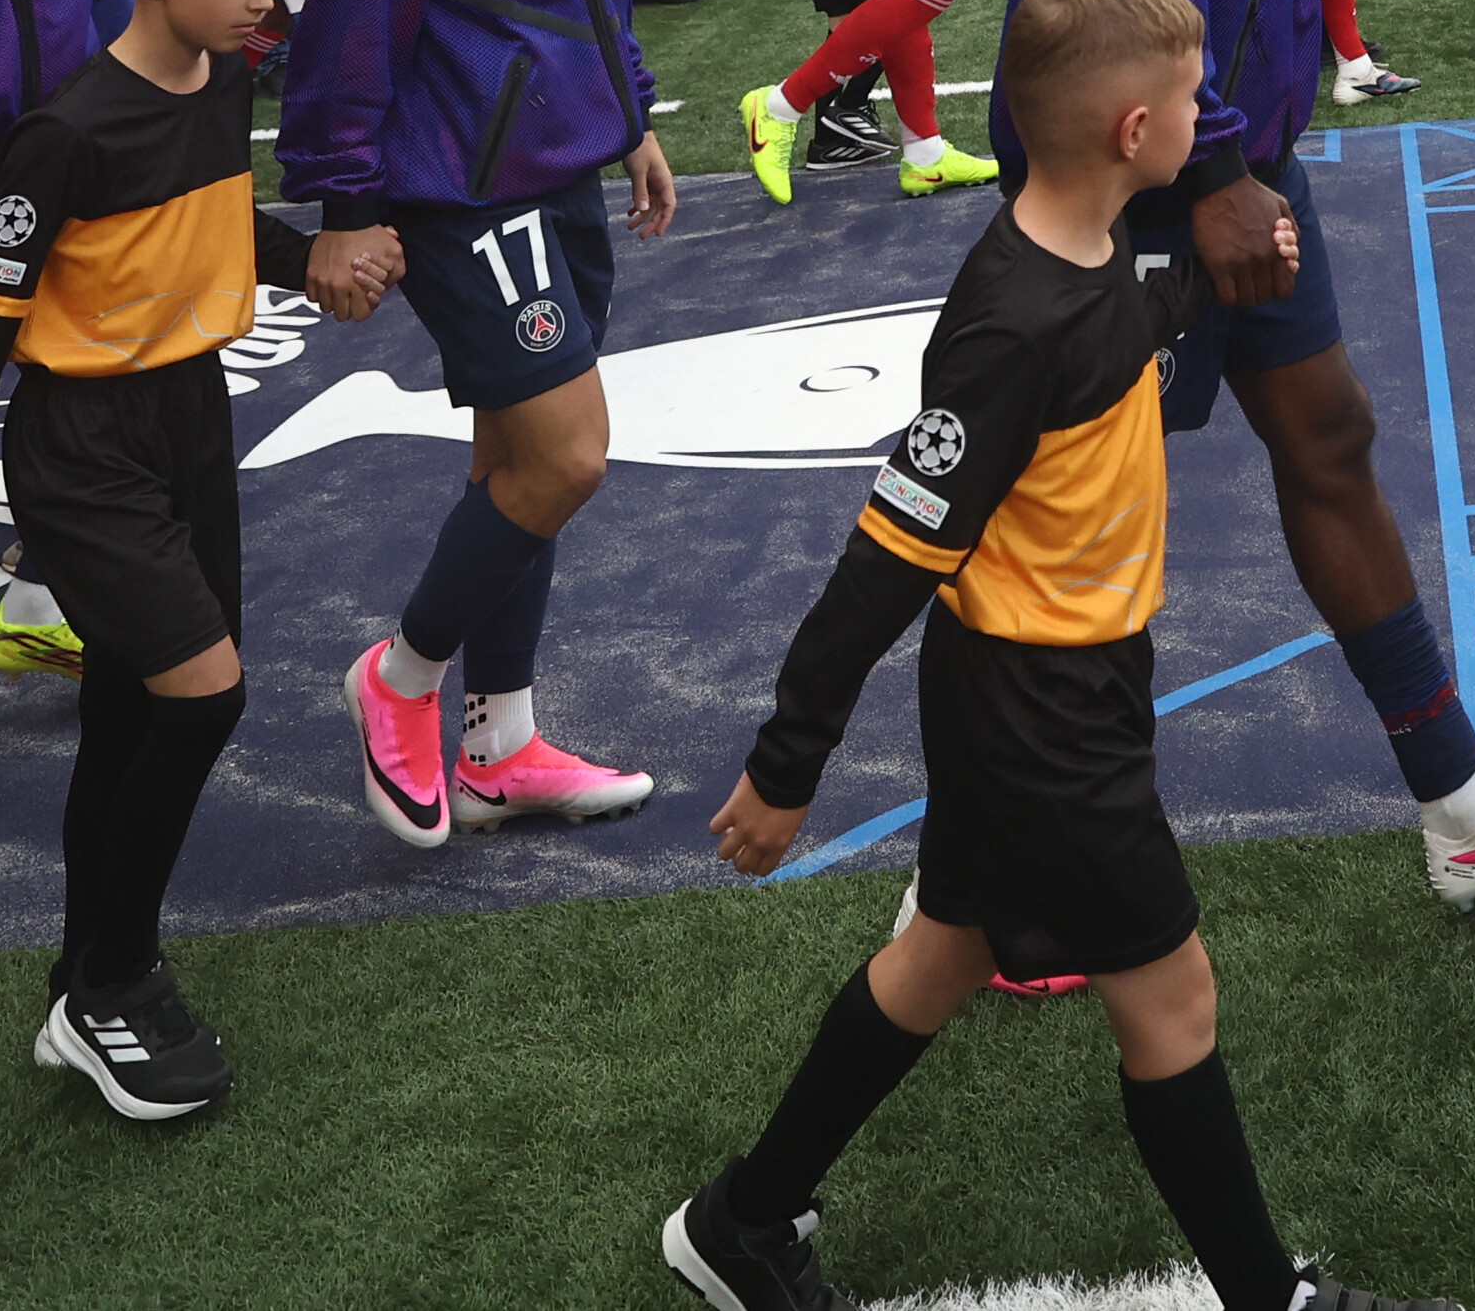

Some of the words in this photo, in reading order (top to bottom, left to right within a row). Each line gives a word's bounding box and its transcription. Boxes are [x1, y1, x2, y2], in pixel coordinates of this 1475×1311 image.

[472, 208, 552, 306] 17
[520, 303, 553, 323] PARIS
[883, 466, 897, 479] UEFA
[879, 472, 944, 518] FOUNDATION
